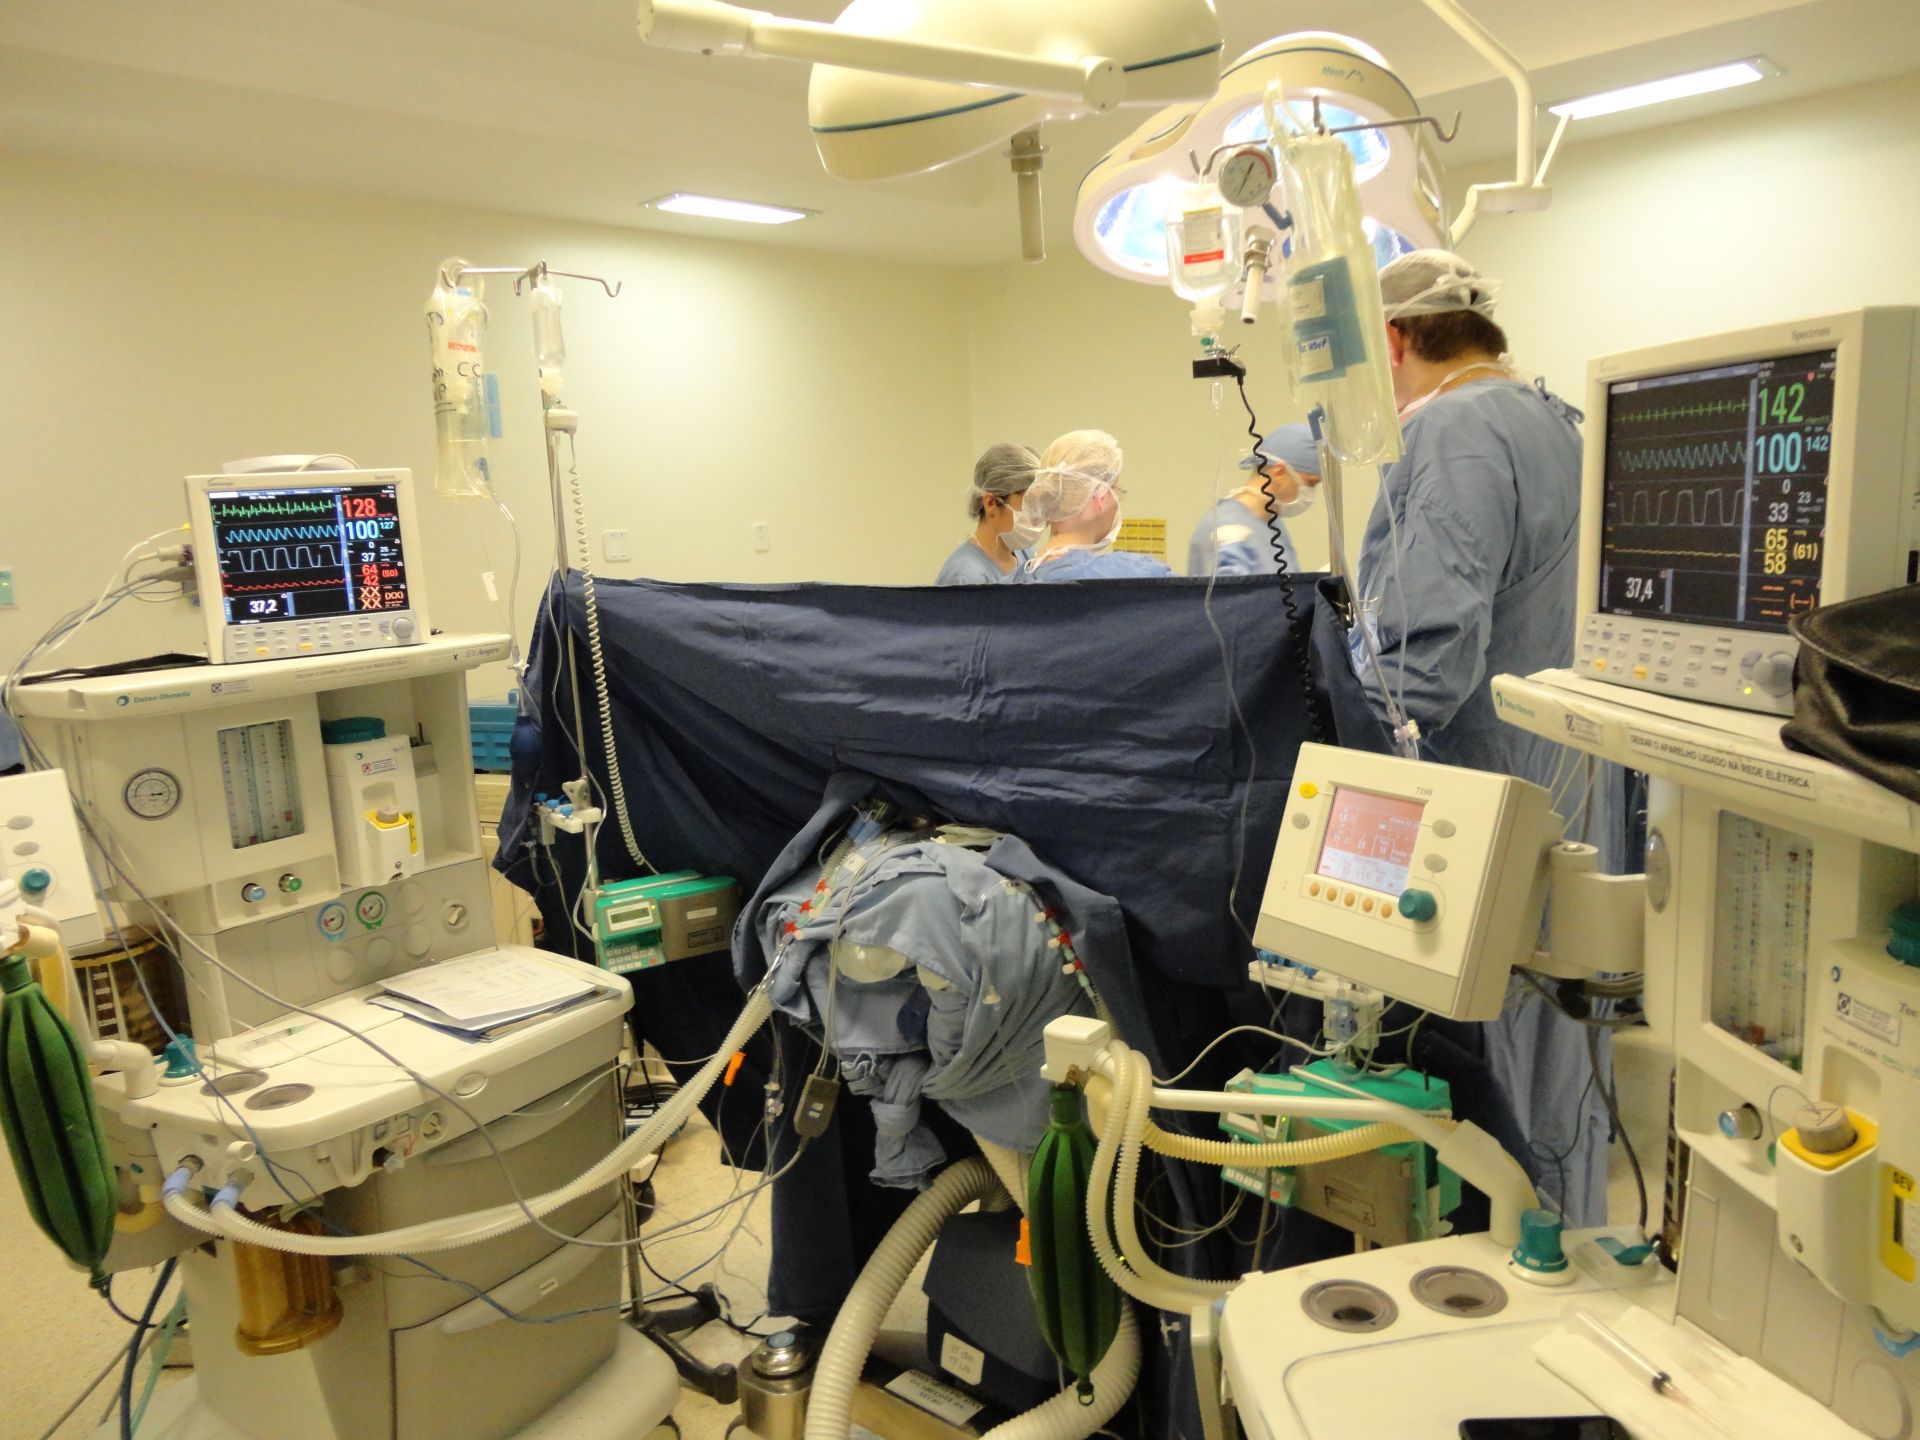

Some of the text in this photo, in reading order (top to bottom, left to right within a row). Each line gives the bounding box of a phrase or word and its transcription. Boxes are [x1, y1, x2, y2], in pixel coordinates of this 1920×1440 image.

[1791, 327, 1831, 344] Spectrum
[1758, 382, 1806, 426] 142
[1755, 431, 1829, 474] 100 142
[1782, 478, 1791, 495] 0
[342, 497, 377, 518] 128
[1768, 501, 1789, 523] 33
[1798, 491, 1811, 504] 23
[345, 519, 395, 540] 100 127
[1764, 527, 1818, 561] 65 (61)
[361, 552, 375, 562] 37
[1764, 551, 1786, 575] 58
[361, 564, 378, 576] 64
[363, 575, 379, 586] 42
[1625, 576, 1653, 603] 37,4
[249, 599, 278, 614] 37,2
[1698, 753, 1727, 768] LIGADO
[1727, 759, 1739, 771] NA
[1740, 762, 1764, 778] REDE
